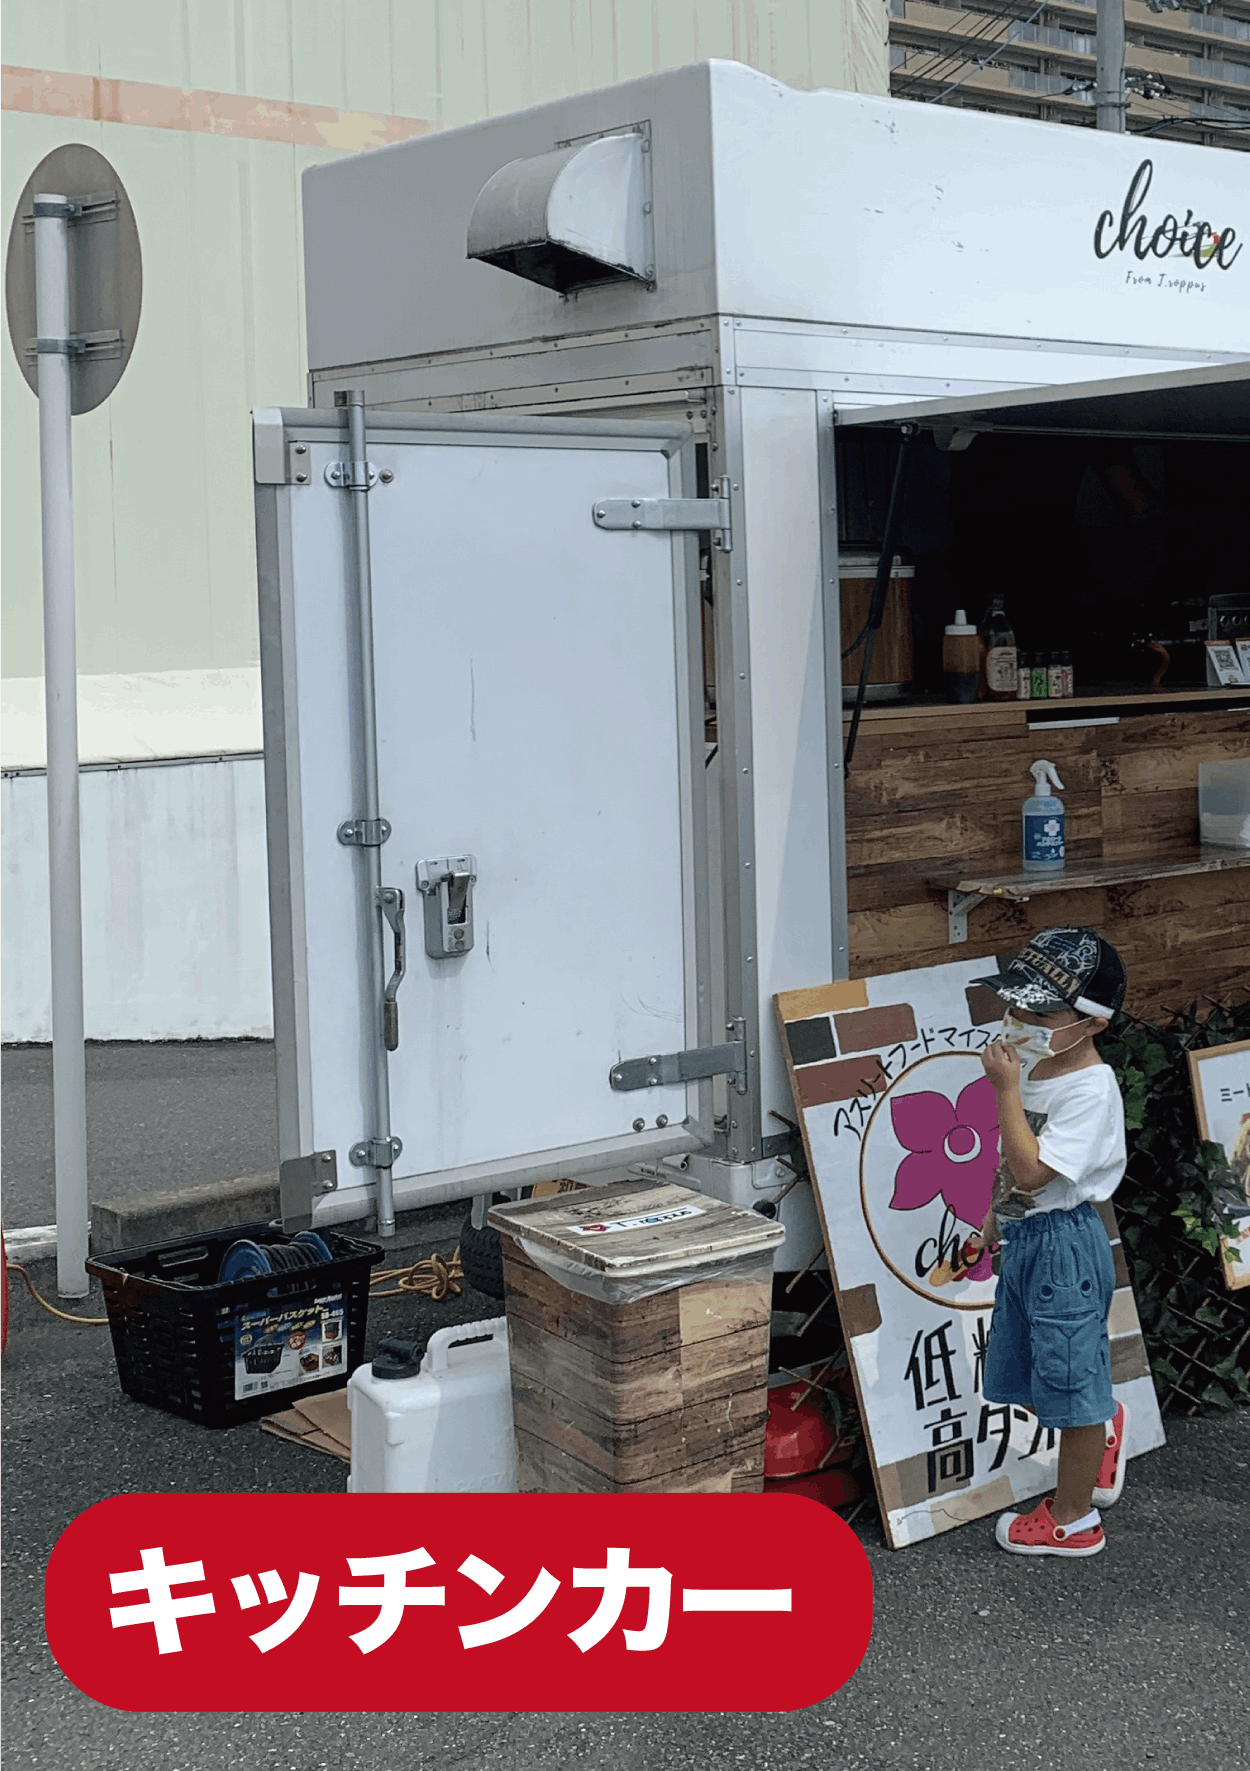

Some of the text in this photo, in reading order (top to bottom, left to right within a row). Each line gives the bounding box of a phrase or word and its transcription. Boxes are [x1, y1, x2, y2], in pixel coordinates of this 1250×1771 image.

[1094, 158, 1243, 270] choice
[834, 1026, 1002, 1142] アスリートフードマイス
